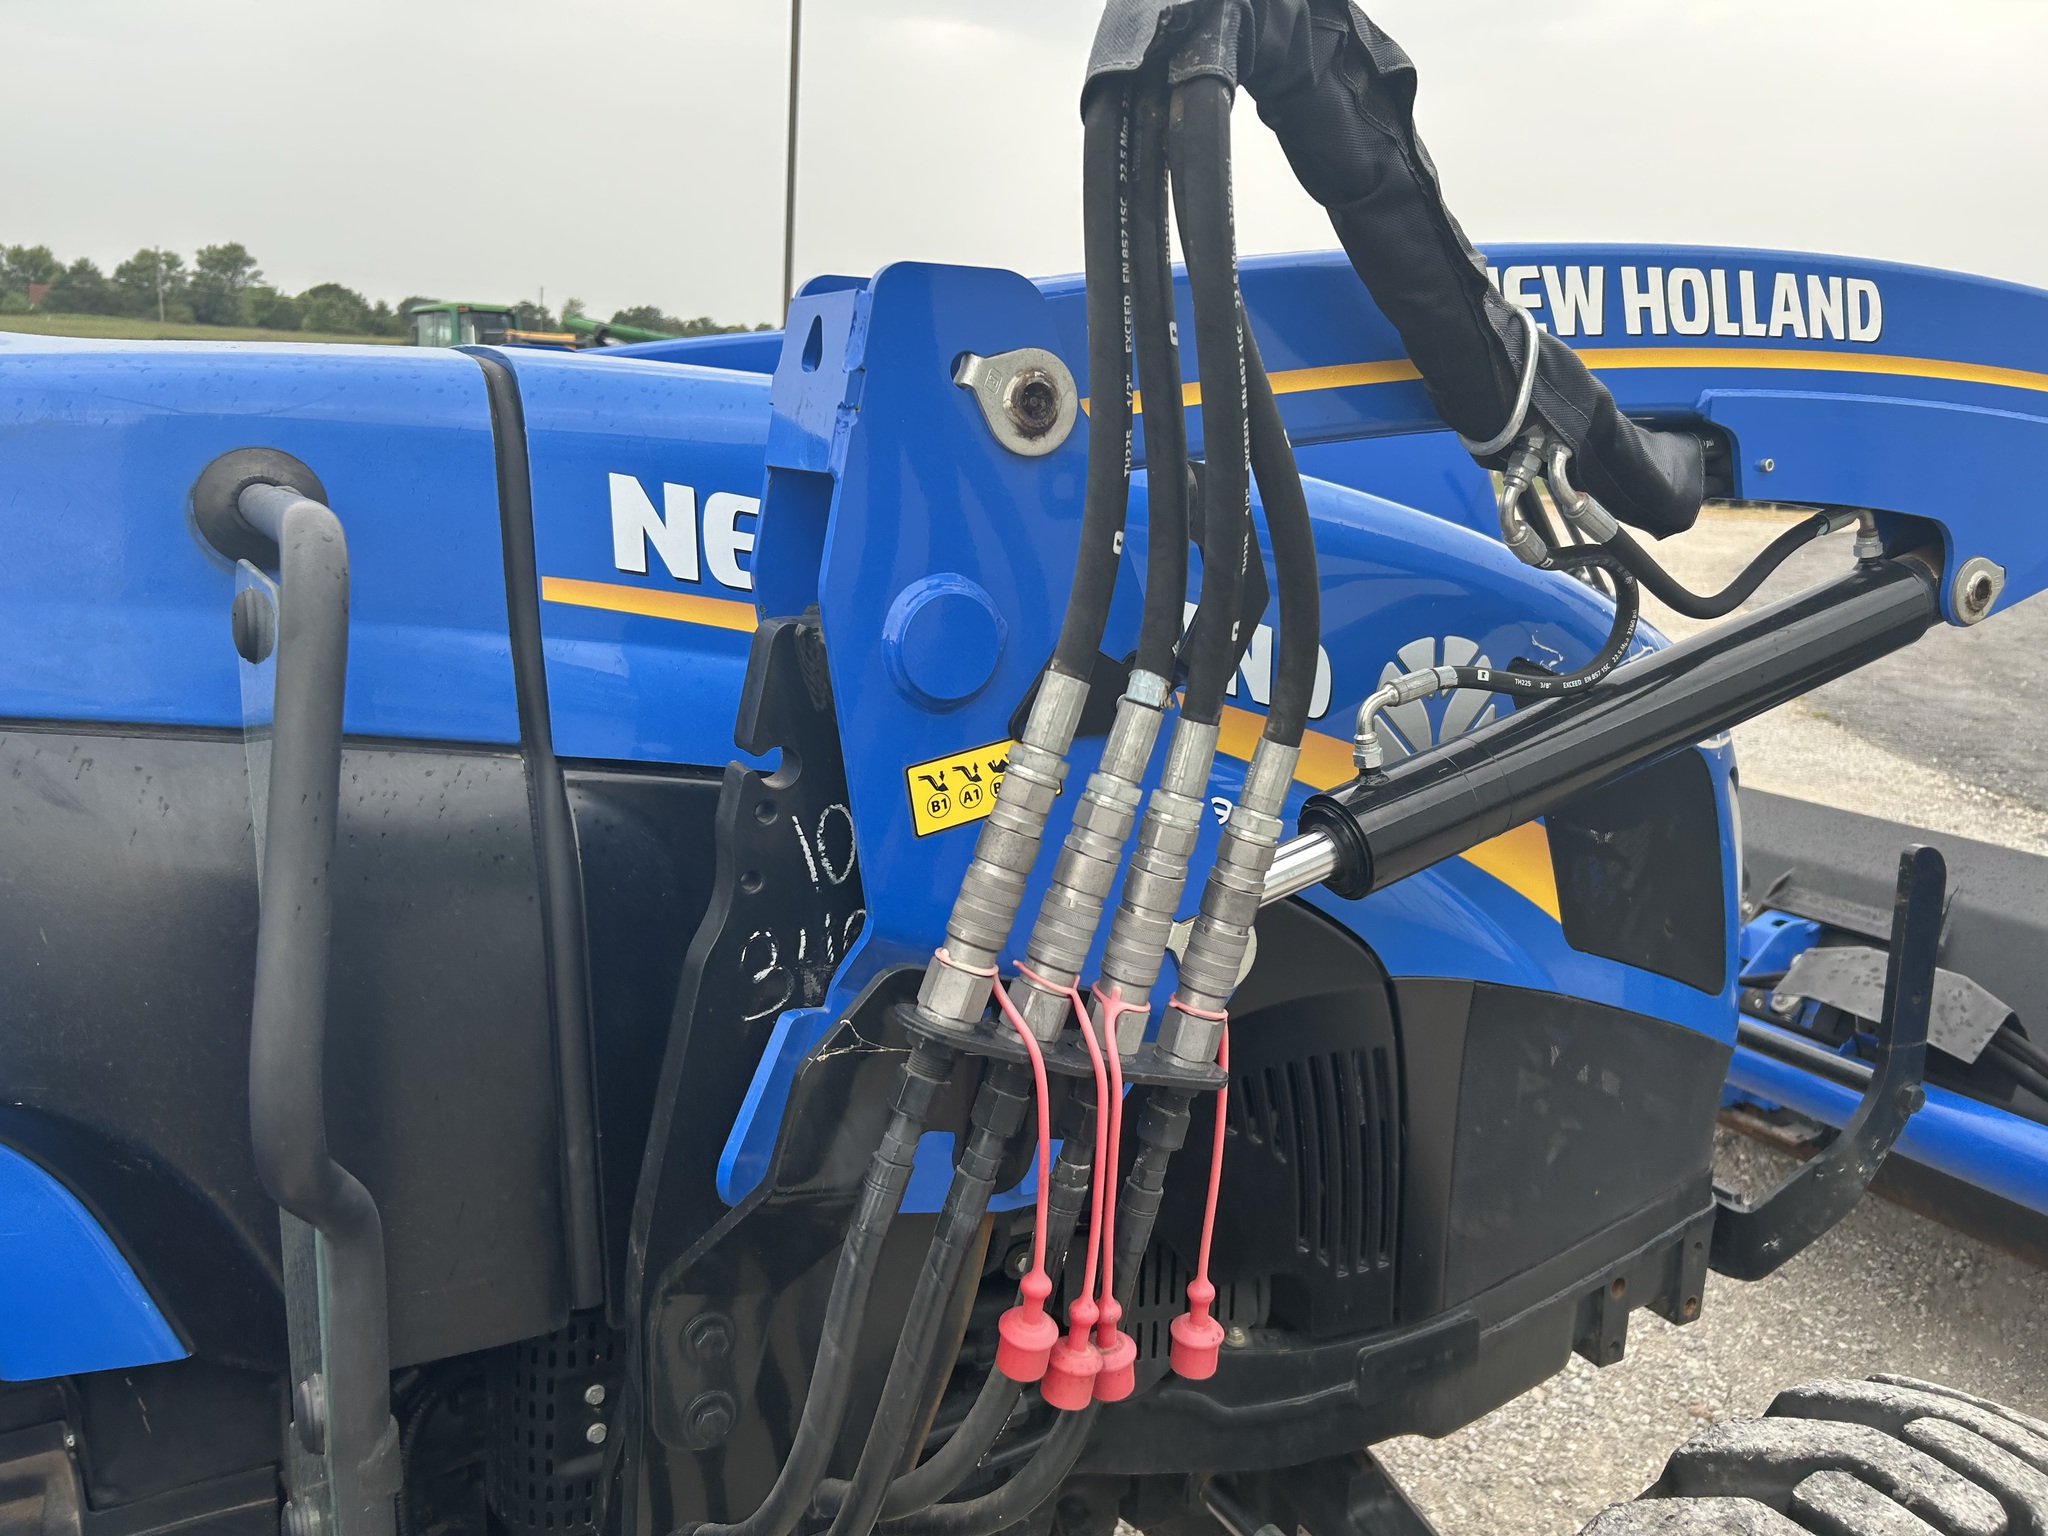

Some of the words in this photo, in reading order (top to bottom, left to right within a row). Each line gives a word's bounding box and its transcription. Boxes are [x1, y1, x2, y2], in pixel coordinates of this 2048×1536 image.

[1119, 149, 1128, 184] 22.5
[1121, 228, 1129, 259] 857
[1122, 262, 1130, 284] EN
[1620, 266, 1883, 342] HOLLAND
[1123, 295, 1133, 353] EXCEED
[1241, 387, 1248, 410] EN
[1514, 677, 1532, 687] TH225
[1562, 679, 1582, 689] EXCEED
[1591, 670, 1601, 680] 857
[931, 798, 948, 813] B1
[963, 788, 980, 804] A1
